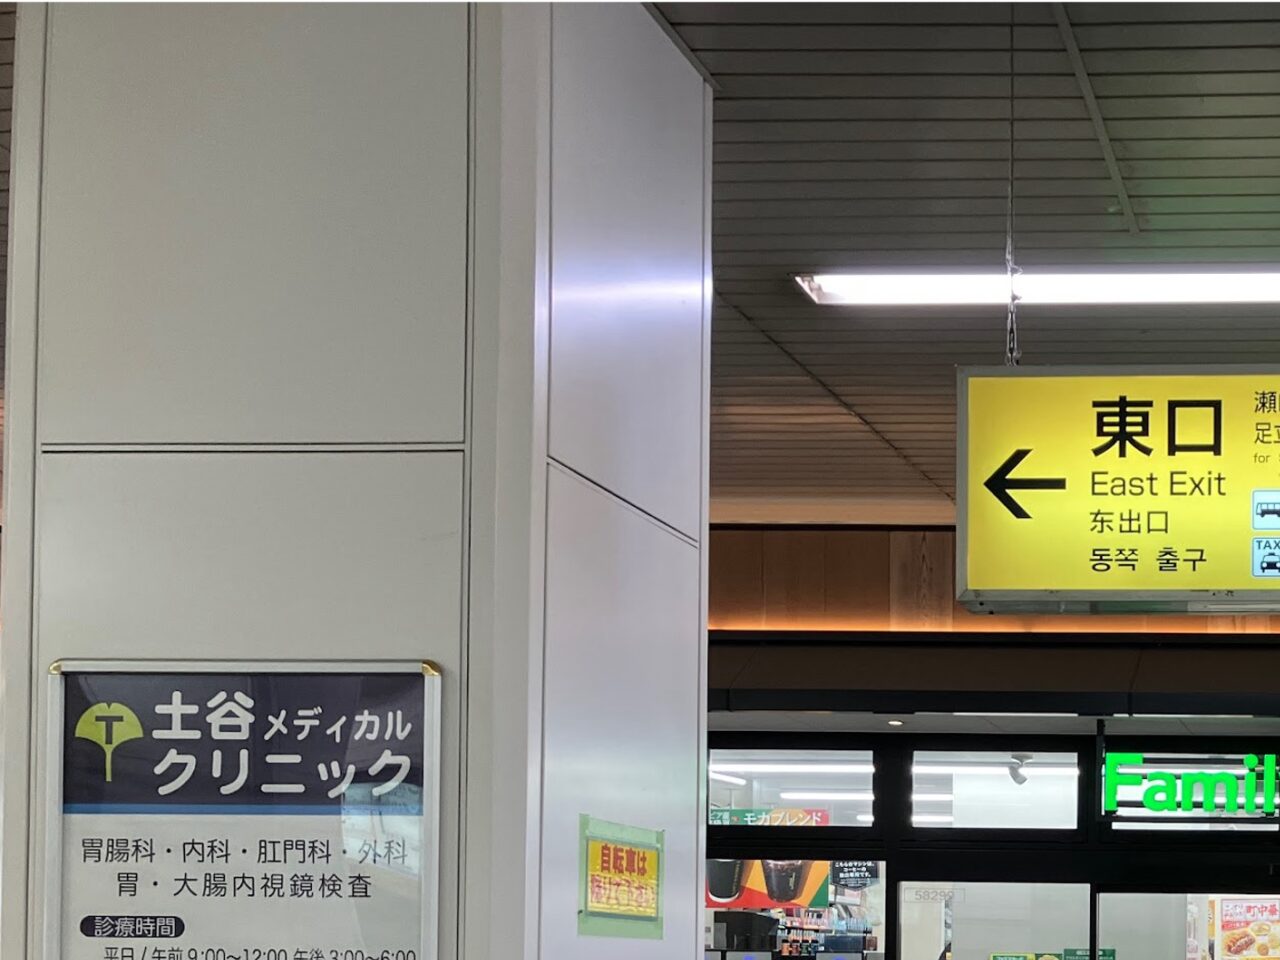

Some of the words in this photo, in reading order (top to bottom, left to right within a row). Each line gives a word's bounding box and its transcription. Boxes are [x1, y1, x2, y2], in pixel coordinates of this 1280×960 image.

[1092, 395, 1222, 457] 東口
[1254, 453, 1270, 463] for
[1092, 471, 1158, 496] East
[1170, 471, 1226, 496] Exit
[1090, 509, 1168, 533] 东出口
[1090, 549, 1138, 572] 동쪽
[1156, 547, 1206, 571] 출구
[153, 748, 411, 798] クリニック
[82, 838, 408, 864] 胃腸科・内科・肛門科・外科
[601, 843, 648, 877] 自転車は
[118, 873, 371, 898] 胃・大腸内視鏡検査
[94, 917, 176, 937] 診療時間
